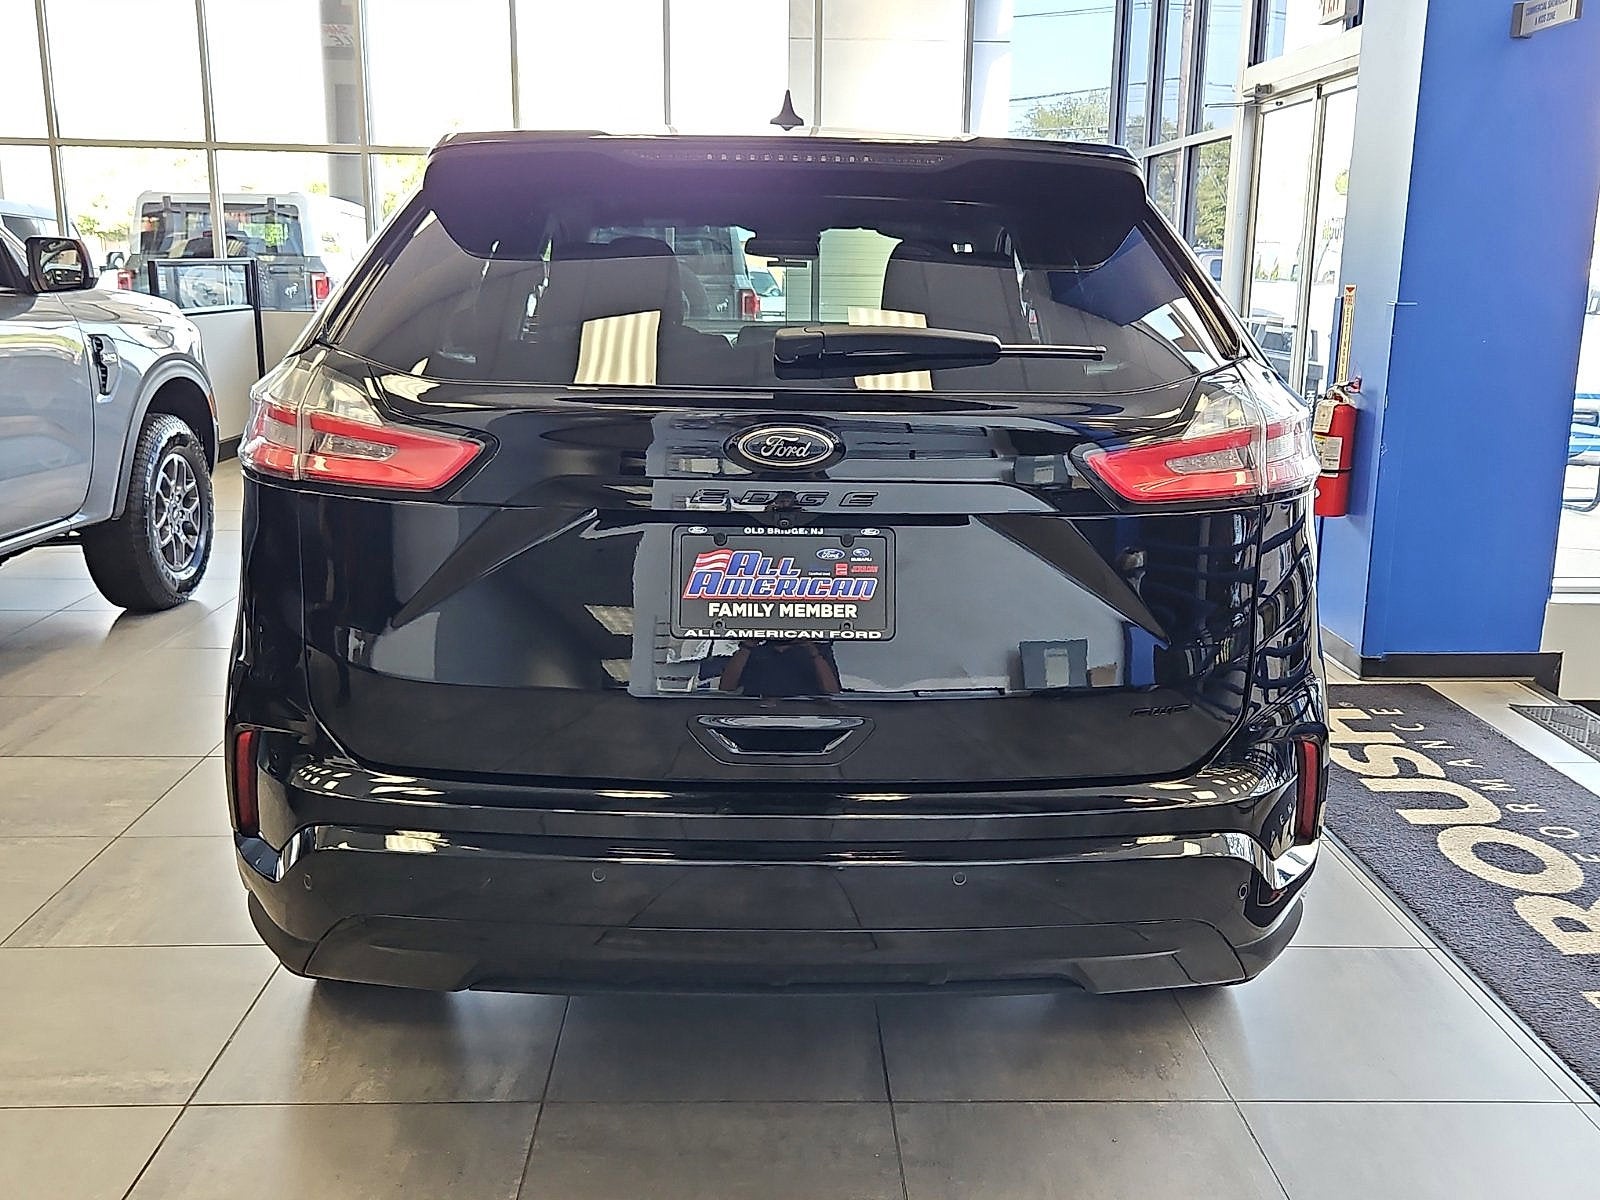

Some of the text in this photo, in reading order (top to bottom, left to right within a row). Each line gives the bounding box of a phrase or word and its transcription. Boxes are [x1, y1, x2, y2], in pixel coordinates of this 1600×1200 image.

[760, 435, 812, 458] Ford
[690, 489, 879, 507] EDGE
[743, 527, 765, 535] OLD
[810, 527, 824, 535] NJ
[726, 550, 801, 578] ALL
[686, 569, 879, 599] AMERICAN
[708, 602, 858, 618] FAMILY MEMBER
[684, 629, 882, 639] ALL AMERICAN FORD
